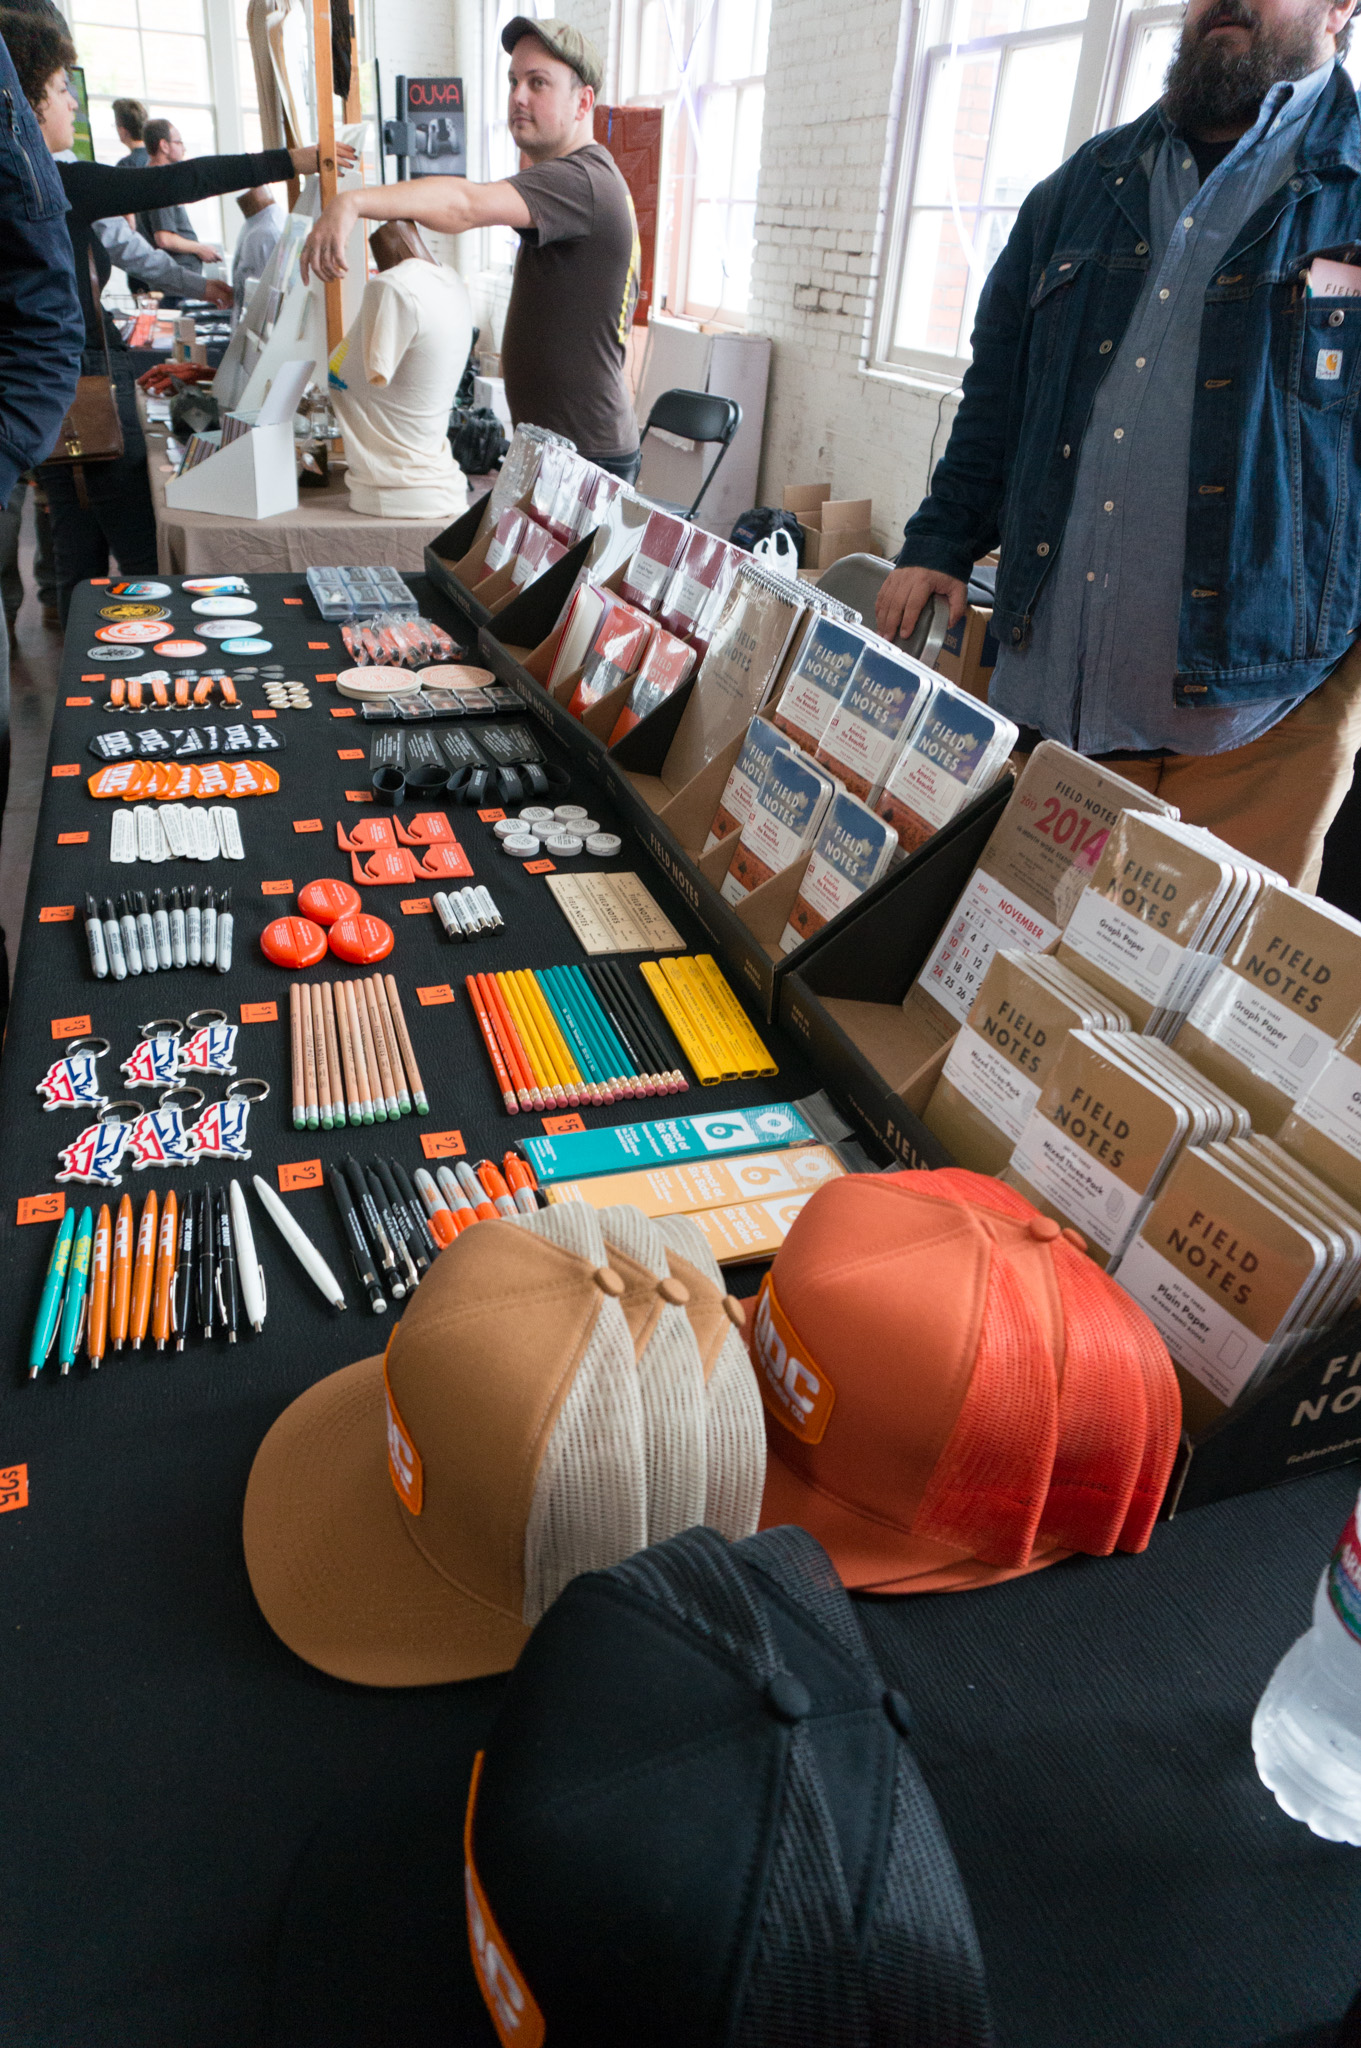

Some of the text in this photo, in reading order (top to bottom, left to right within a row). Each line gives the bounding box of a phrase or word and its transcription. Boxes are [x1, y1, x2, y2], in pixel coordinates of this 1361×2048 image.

[409, 84, 461, 105] OUYA
[804, 659, 840, 687] NOTES
[815, 645, 844, 669] FIELD
[850, 691, 890, 724] NOTES
[862, 677, 894, 704] FIELD
[932, 721, 965, 750] FIELD
[919, 735, 960, 772] NOTES
[742, 758, 765, 784] NOTE
[762, 793, 796, 828] NOTES
[771, 779, 798, 808] FIELD
[1055, 780, 1118, 826] FIELD NOTES
[834, 826, 863, 856] FIELD
[1032, 790, 1111, 867] 2014
[650, 833, 700, 907] FIELD NOTES
[825, 842, 859, 877] NOTES
[1123, 859, 1178, 902] FIELD
[997, 896, 1044, 941] NOVEMBER
[1105, 877, 1172, 929] NOTES
[948, 935, 982, 969] 10 11 12
[958, 922, 989, 953] 3 4 5
[1097, 916, 1145, 955] Graph Paper
[940, 950, 974, 984] 17 18 19
[1265, 935, 1332, 985] FIELD
[429, 989, 447, 999] $1
[932, 964, 967, 999] 24 25 26
[1245, 954, 1324, 1014] NOTES
[64, 1020, 86, 1032] $3
[251, 1006, 272, 1016] $1
[998, 1000, 1047, 1047] FIELD
[1232, 998, 1288, 1045] Graph Paper
[982, 1016, 1042, 1073] NOTES
[558, 1119, 579, 1132] $5
[1070, 1086, 1130, 1140] FIELD
[436, 1136, 458, 1150] $2
[653, 1123, 681, 1153] Six Sides
[664, 1121, 691, 1150] Pencil of
[1053, 1104, 1126, 1168] NOTES
[292, 1165, 317, 1182] $2
[686, 1166, 715, 1200] Six Sides
[698, 1164, 725, 1196] Pencil of
[1042, 1139, 1105, 1195] Mixed Three-Pack
[32, 1198, 58, 1216] $2
[734, 1206, 767, 1239] Pencil of
[721, 1209, 755, 1244] Six Sides
[1188, 1210, 1259, 1274] FIELD
[1166, 1228, 1252, 1306] NOTES
[1156, 1281, 1211, 1336] Plain Paper
